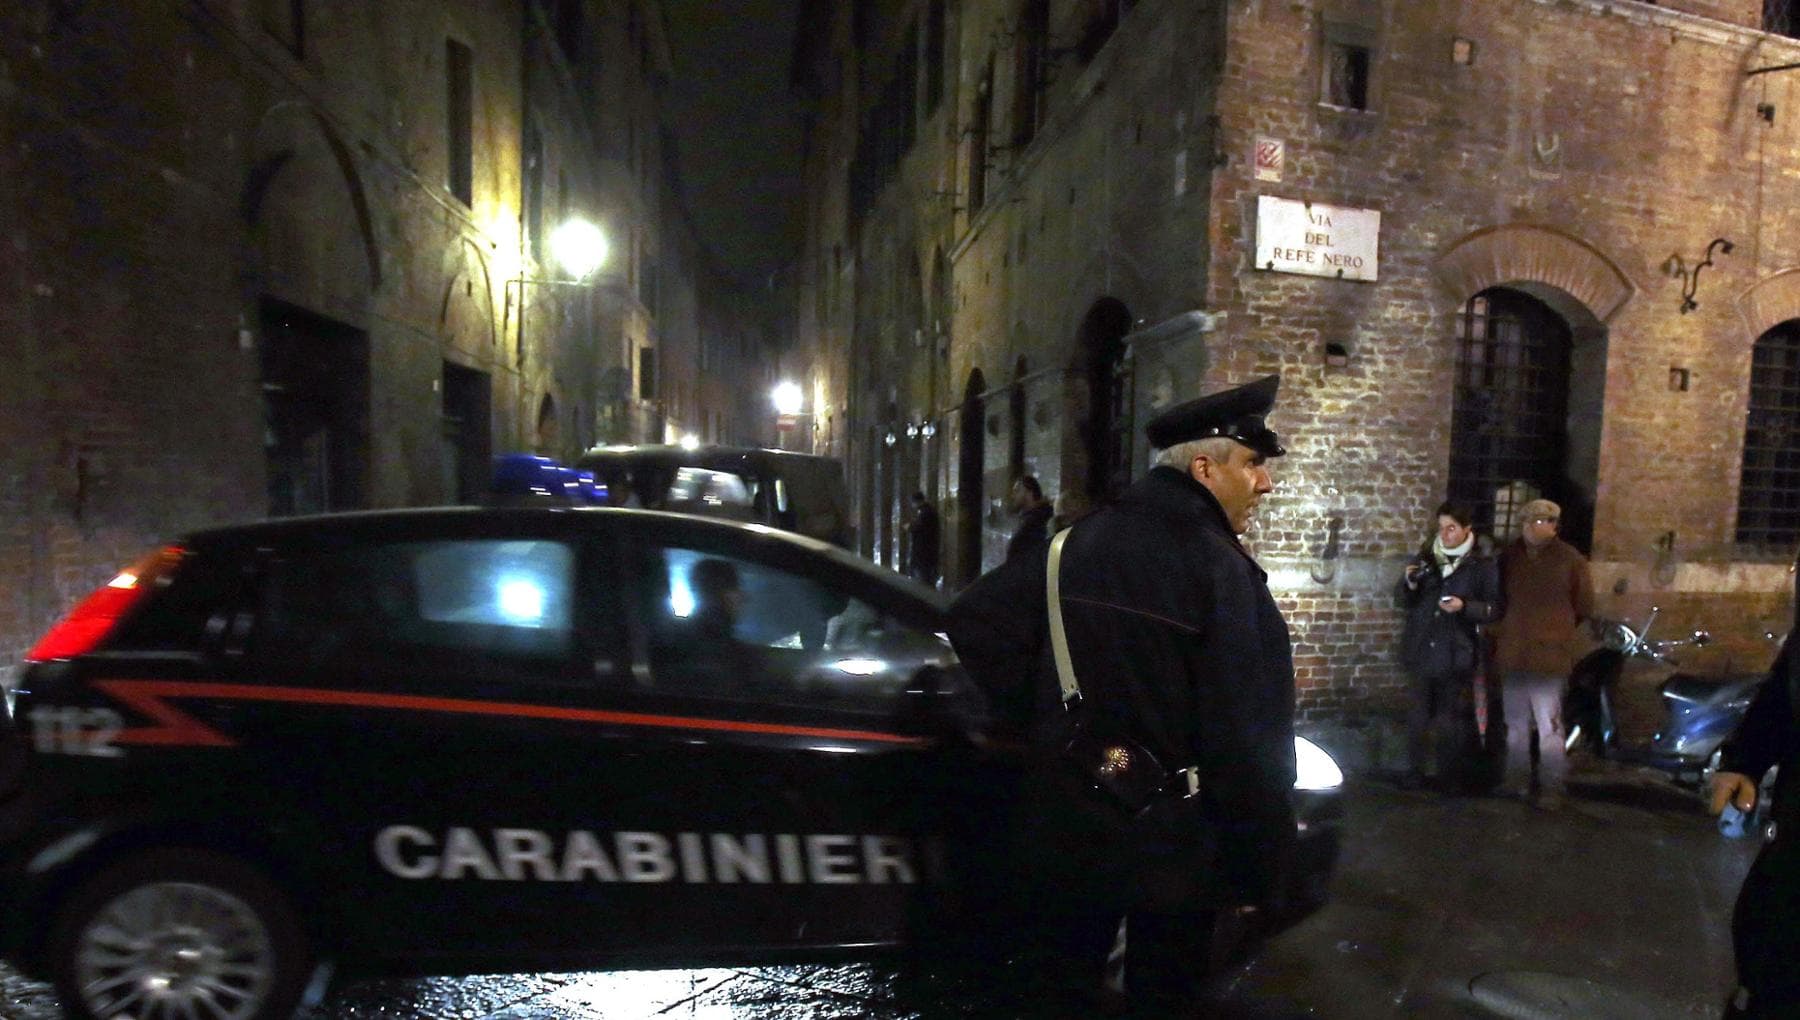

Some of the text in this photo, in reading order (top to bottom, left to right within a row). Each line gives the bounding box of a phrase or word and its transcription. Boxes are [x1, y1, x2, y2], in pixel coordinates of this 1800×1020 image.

[1308, 213, 1333, 228] VIA
[1305, 232, 1334, 248] DEL
[1273, 247, 1363, 268] REFE NERO
[30, 704, 125, 757] 112
[375, 825, 918, 885] CARABINIER
